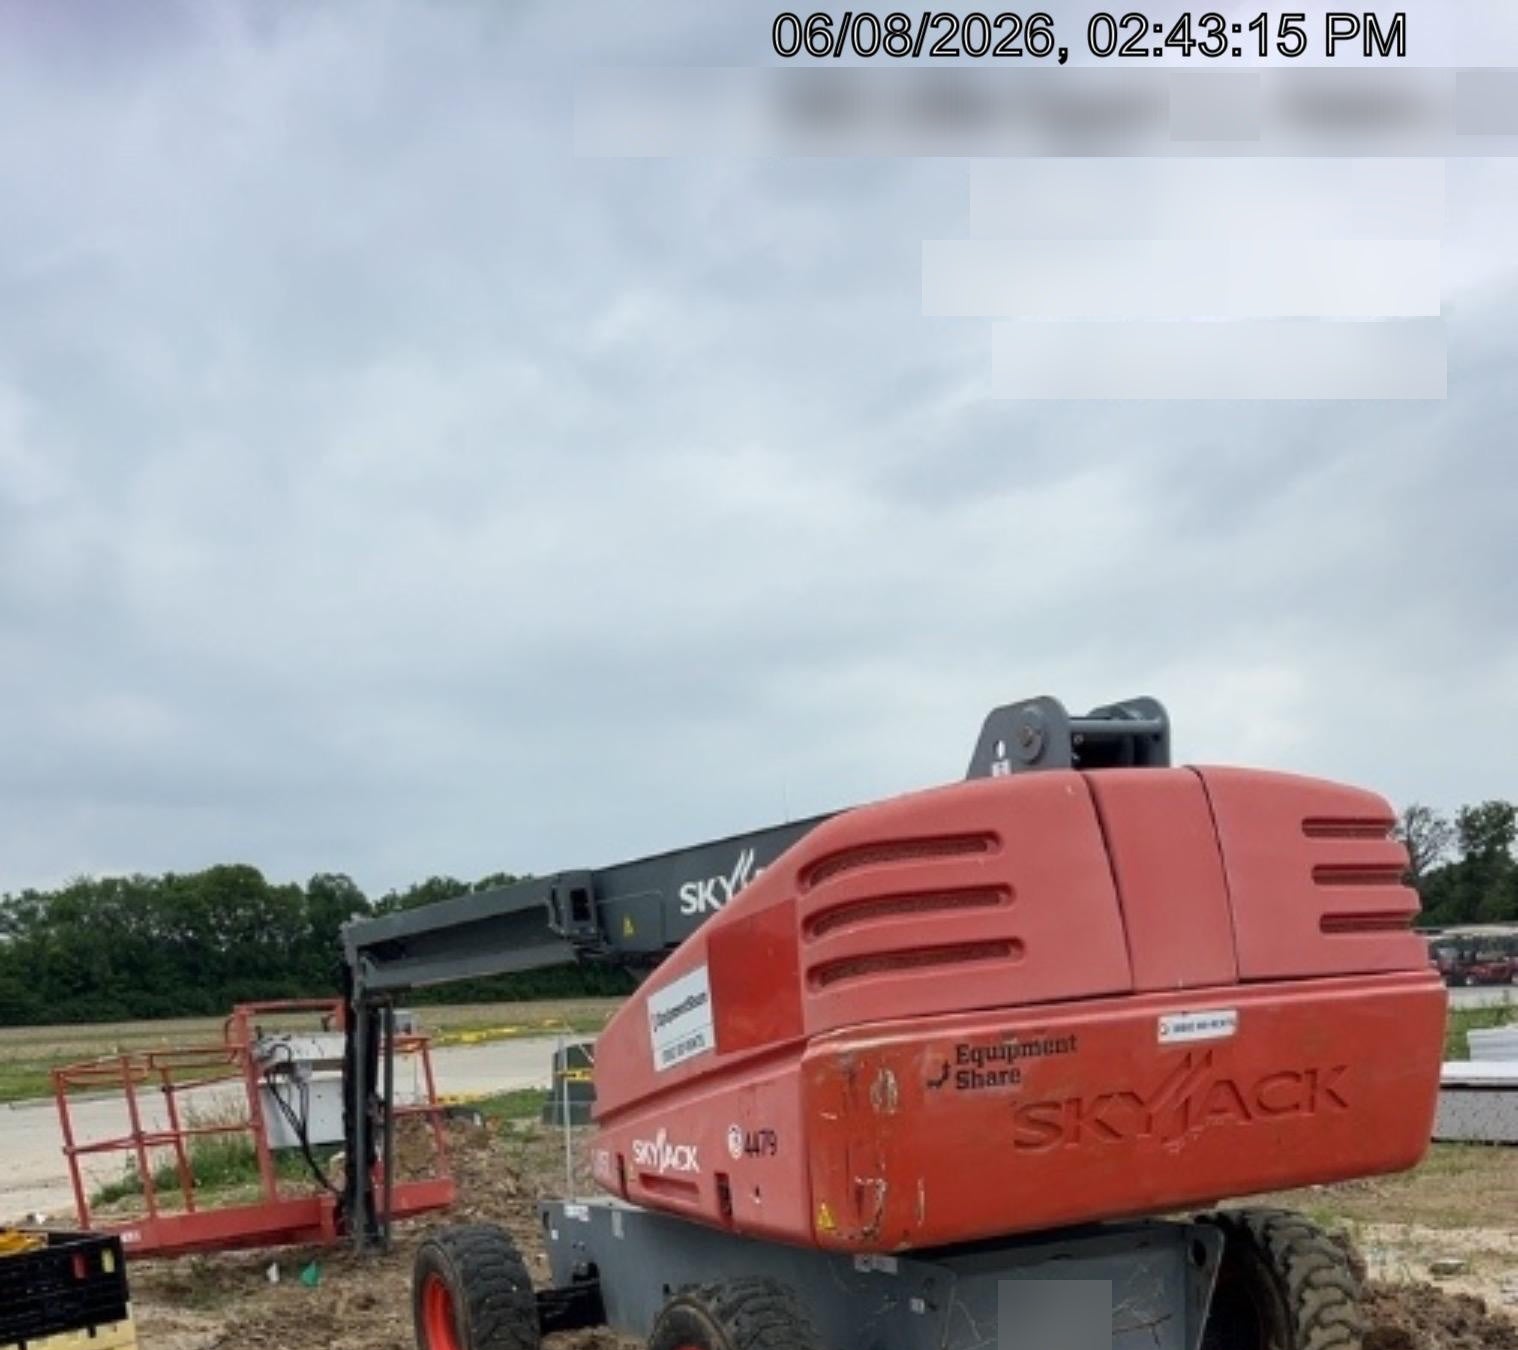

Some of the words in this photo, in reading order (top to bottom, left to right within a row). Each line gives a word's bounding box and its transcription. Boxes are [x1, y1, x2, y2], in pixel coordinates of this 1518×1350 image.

[955, 1034, 1077, 1068] Equipment
[955, 1067, 1021, 1090] Share
[1012, 1049, 1349, 1152] SKYJACK
[632, 1127, 701, 1174] SKYJACK
[743, 1128, 778, 1158] 4479
